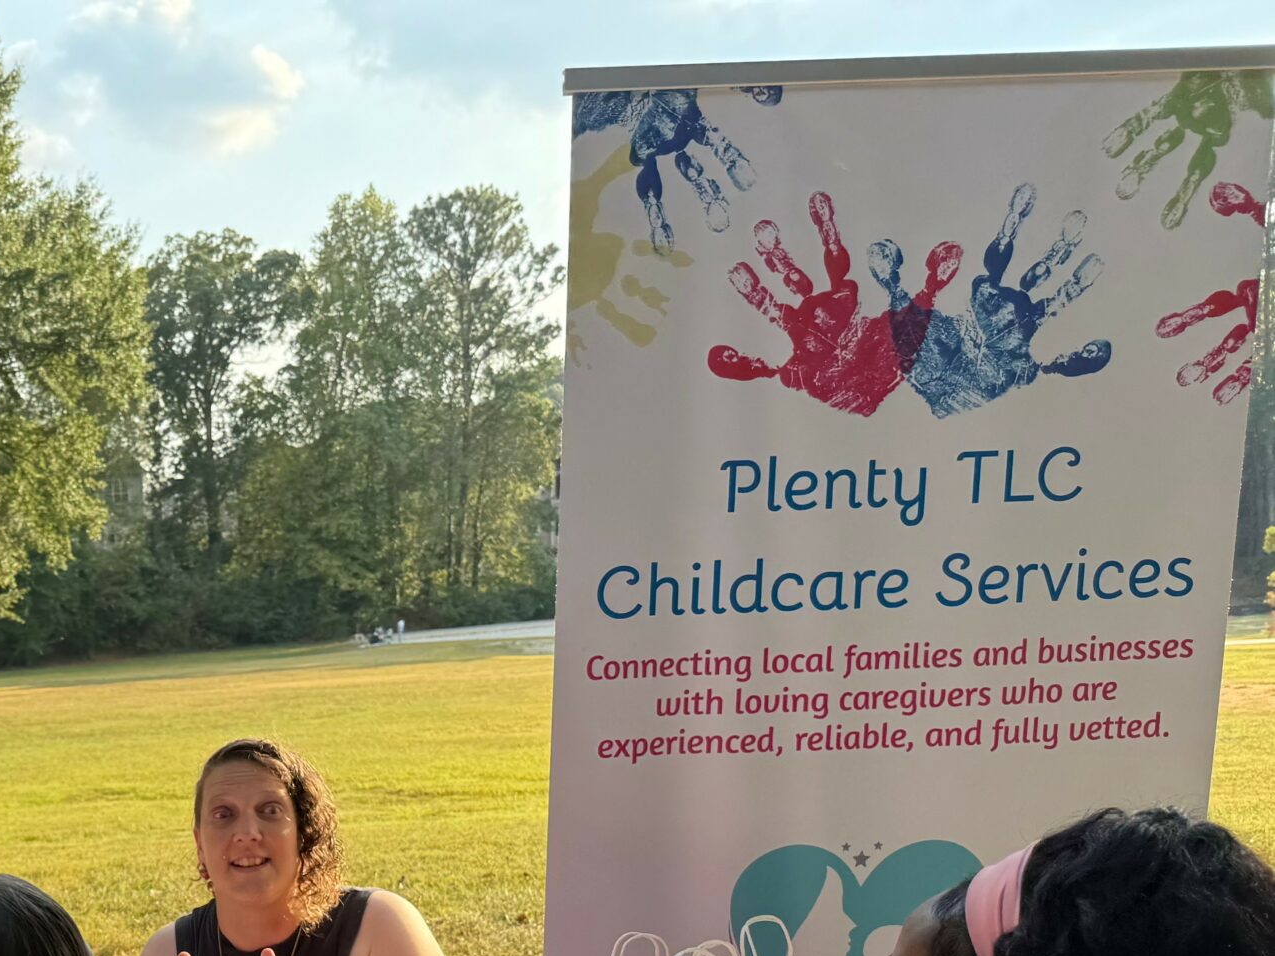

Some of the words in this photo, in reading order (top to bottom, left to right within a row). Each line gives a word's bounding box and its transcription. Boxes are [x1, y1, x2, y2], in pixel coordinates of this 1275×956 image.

[722, 456, 928, 527] Plenty
[958, 447, 1083, 505] TLC
[598, 559, 909, 620] Childcare
[936, 548, 1194, 608] Services
[586, 649, 752, 684] Connecting
[762, 645, 833, 674] local
[844, 642, 963, 678] families
[972, 639, 1028, 668] and
[1038, 638, 1194, 664] businesses
[656, 687, 725, 717] with
[735, 687, 829, 721] loving
[838, 687, 992, 717] caregivers
[1001, 678, 1063, 705] who
[1072, 680, 1118, 702] are
[597, 726, 783, 764] experienced,
[795, 722, 914, 753] reliable,
[924, 719, 983, 748] and
[991, 717, 1059, 752] fully
[1069, 712, 1170, 742] vetted.
